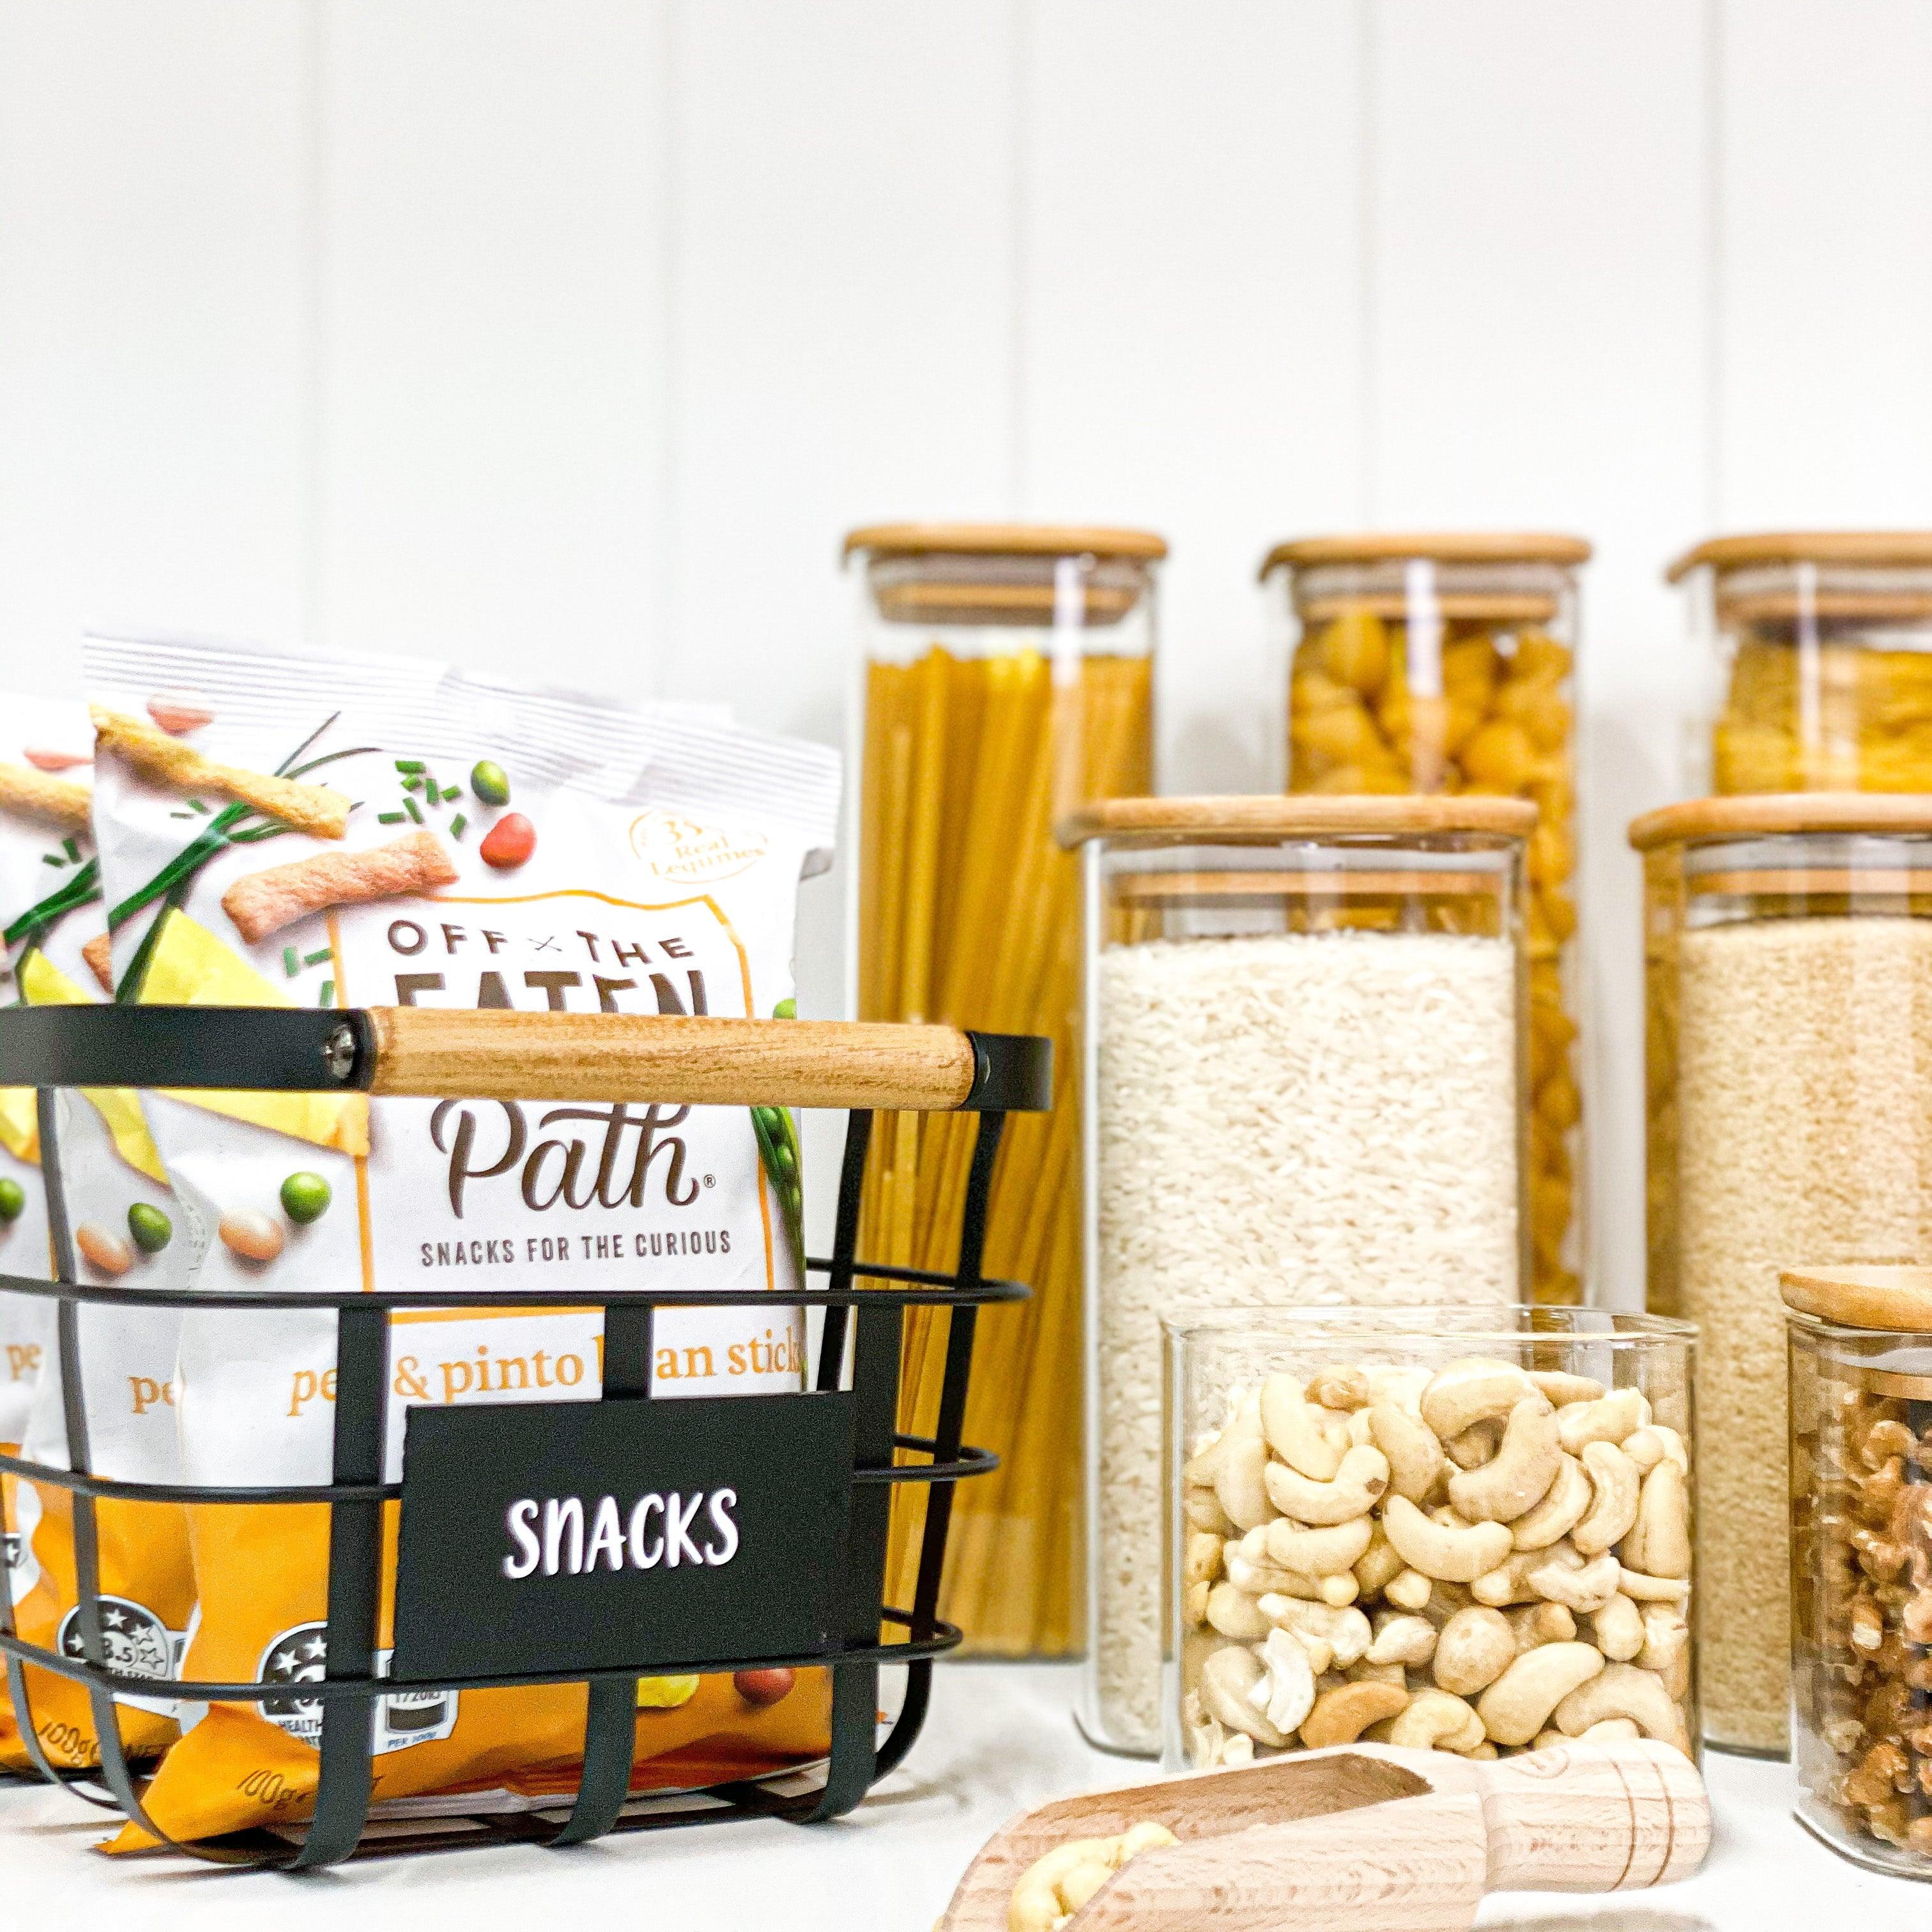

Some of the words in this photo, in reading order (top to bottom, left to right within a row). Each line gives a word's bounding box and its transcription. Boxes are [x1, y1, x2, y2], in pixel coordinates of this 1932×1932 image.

[649, 847, 766, 876] Legumes
[675, 835, 730, 859] Real
[387, 919, 509, 955] OFF
[576, 930, 695, 968] THE
[430, 1099, 700, 1219] Path
[421, 1239, 515, 1268] SNACKS
[527, 1236, 571, 1262] FOR
[581, 1234, 625, 1260] THE
[636, 1229, 732, 1258] CURIOUS
[5, 1343, 42, 1381] pe
[286, 1368, 338, 1416] pe
[438, 1345, 584, 1404] pinto
[128, 1375, 178, 1414] pe
[503, 1487, 739, 1579] SNACKS
